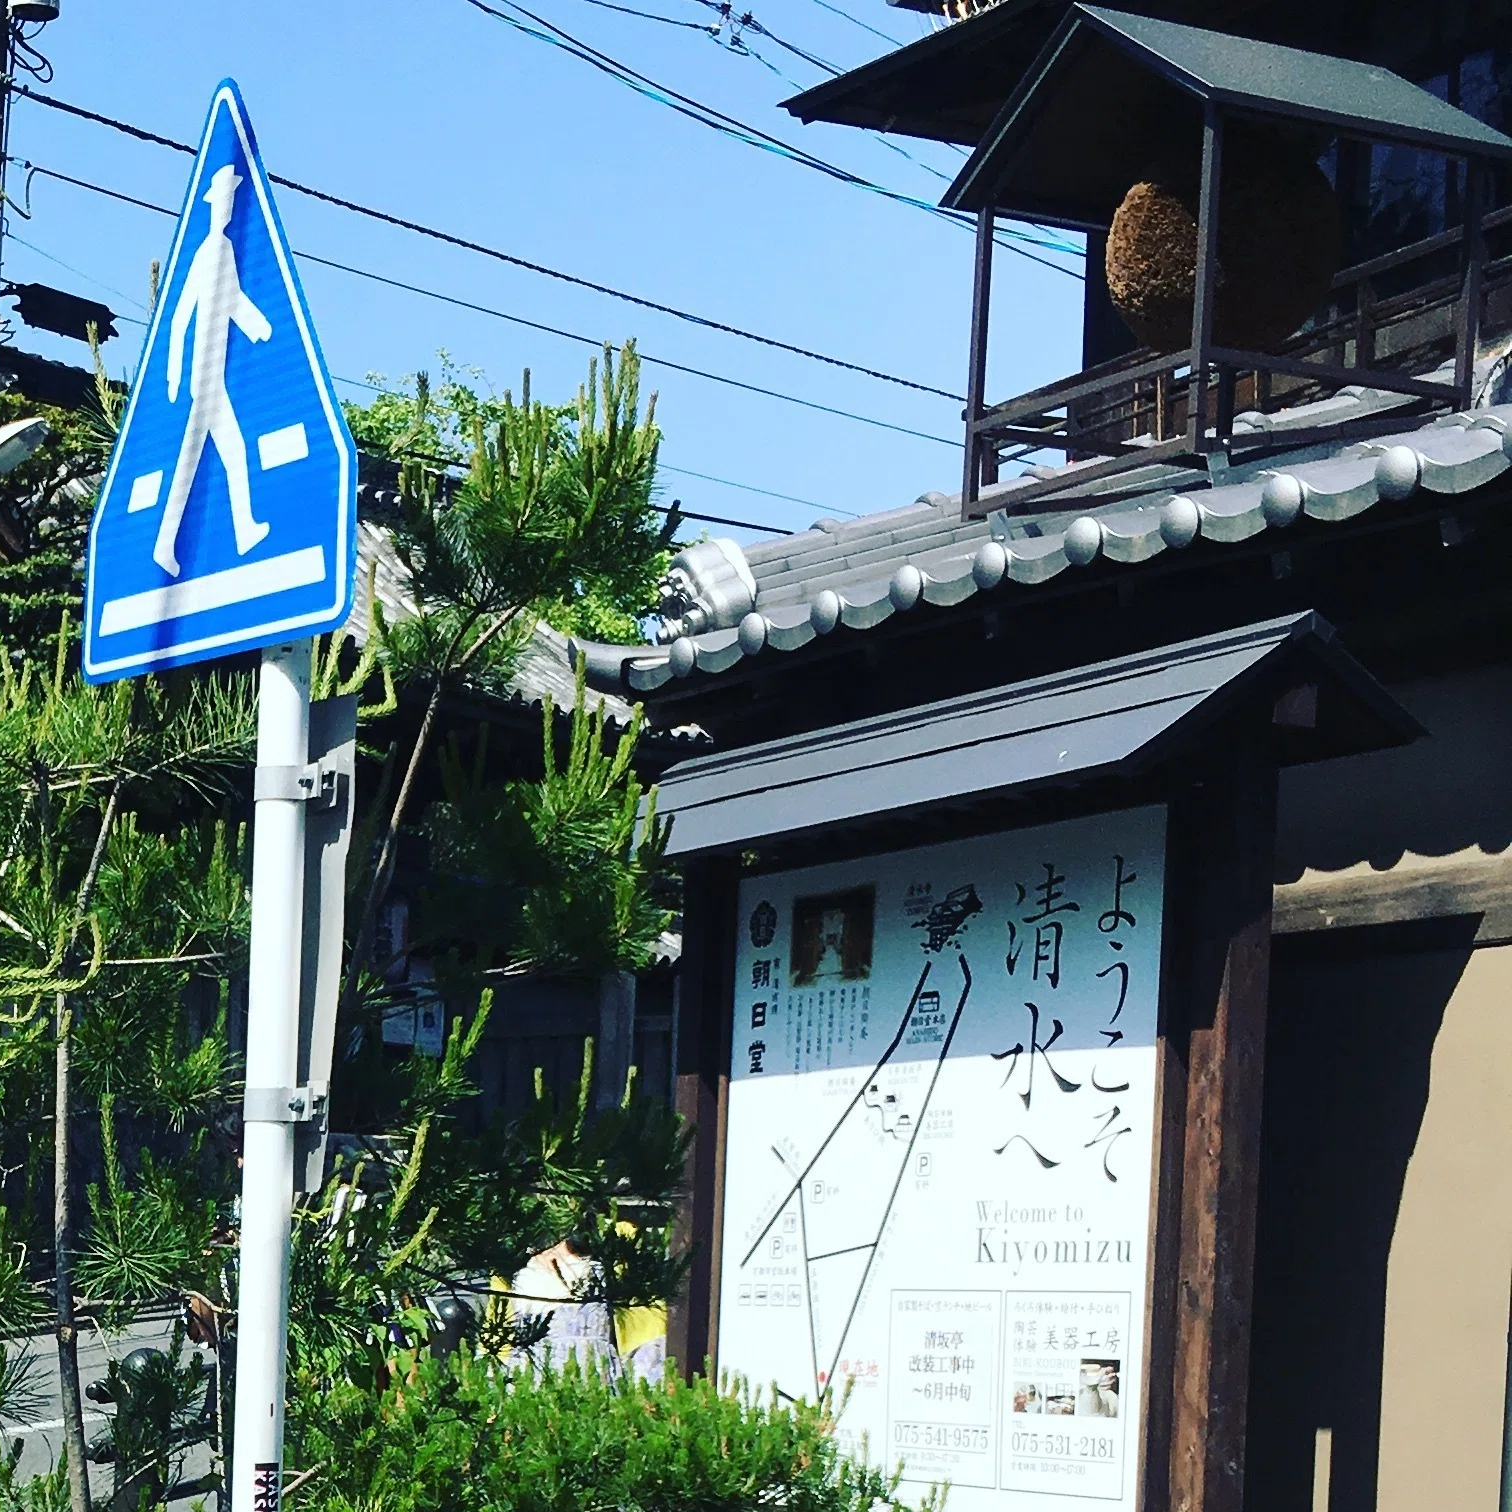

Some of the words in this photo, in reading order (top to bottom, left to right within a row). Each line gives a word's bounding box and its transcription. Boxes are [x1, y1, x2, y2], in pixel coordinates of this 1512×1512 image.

[748, 959, 771, 1074] 朝日堂
[991, 863, 1082, 1170] 清水へ
[1083, 855, 1138, 1183] ようこそ
[975, 1201, 1058, 1223] Welcome
[1064, 1205, 1084, 1223] to
[975, 1228, 1132, 1280] Kiyomizu
[1043, 1325, 1120, 1353] 美器工房
[909, 1355, 975, 1374] 改装工事中
[894, 1423, 989, 1450] 075-541-9575
[1012, 1432, 1115, 1459] 075-531-2181
